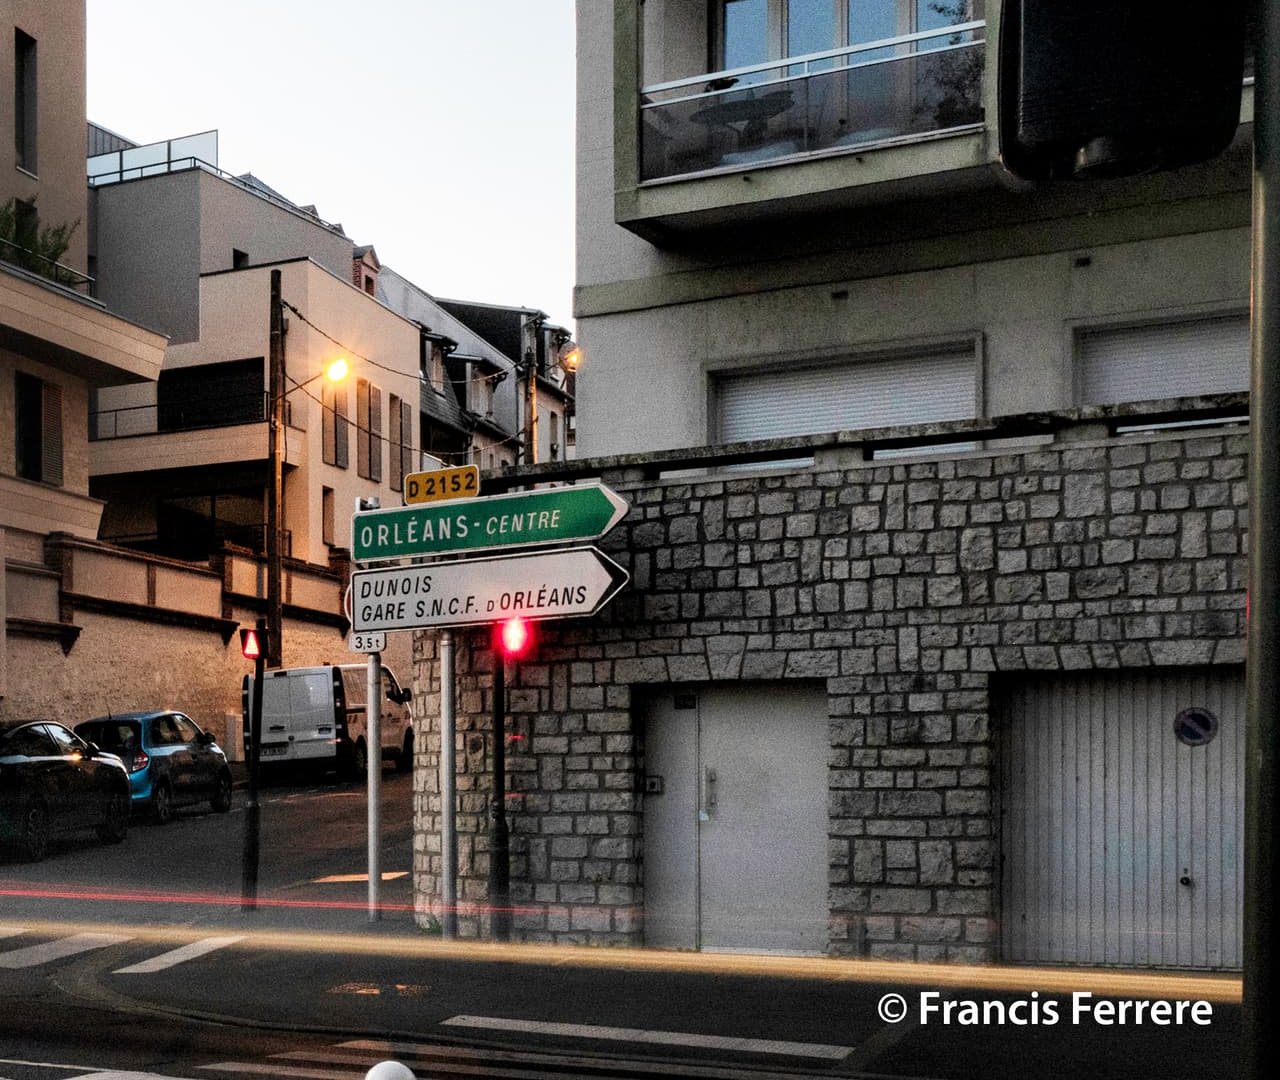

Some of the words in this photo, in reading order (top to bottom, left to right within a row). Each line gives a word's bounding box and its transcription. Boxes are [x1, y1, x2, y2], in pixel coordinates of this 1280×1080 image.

[409, 480, 419, 497] D
[425, 472, 475, 496] 2152
[361, 576, 433, 599] DUNOIS
[361, 602, 406, 622] GARE
[415, 596, 479, 618] S.N.C.F.
